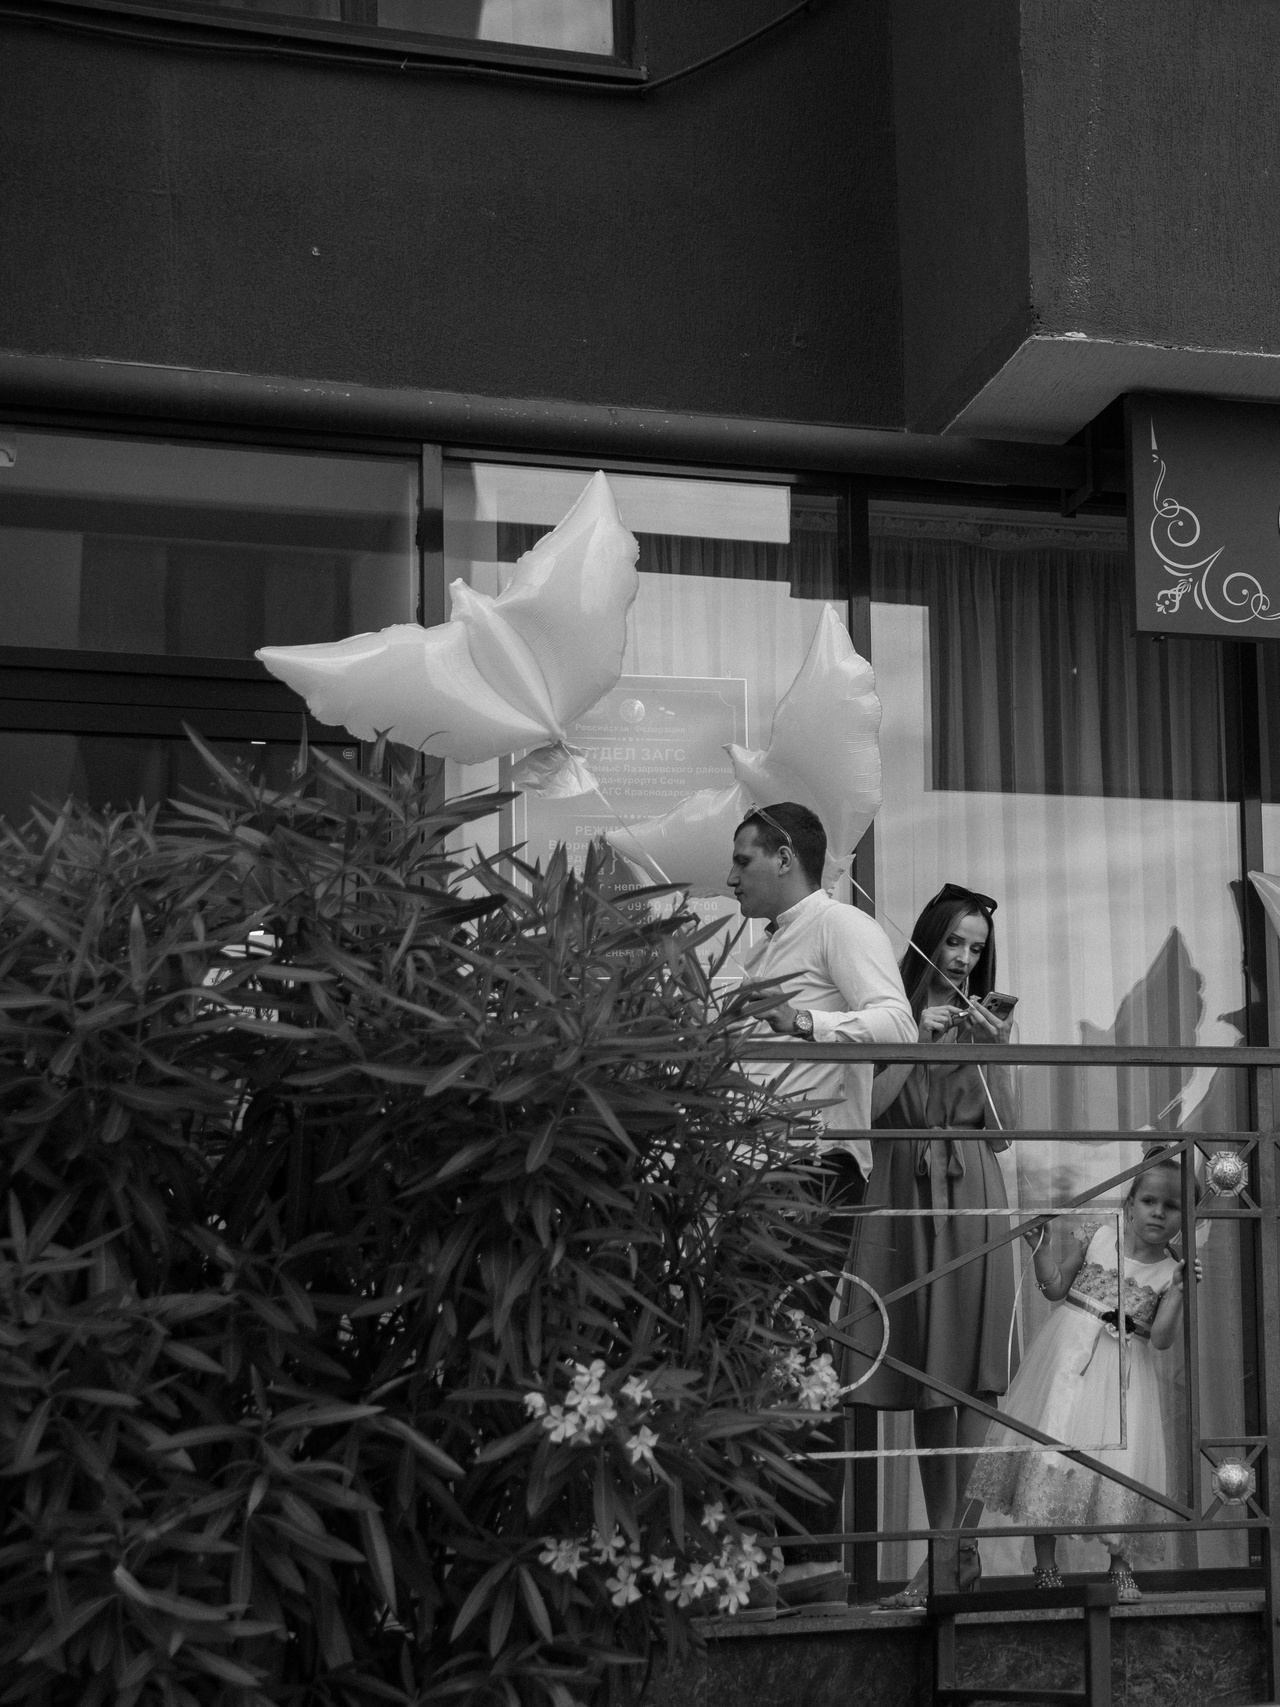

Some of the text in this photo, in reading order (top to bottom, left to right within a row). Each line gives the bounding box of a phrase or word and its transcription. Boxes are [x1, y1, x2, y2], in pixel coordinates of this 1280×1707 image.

[641, 748, 686, 761] ЗАГС
[623, 764, 693, 774] Лазаревского
[695, 766, 733, 775] района
[660, 776, 686, 785] Сочи
